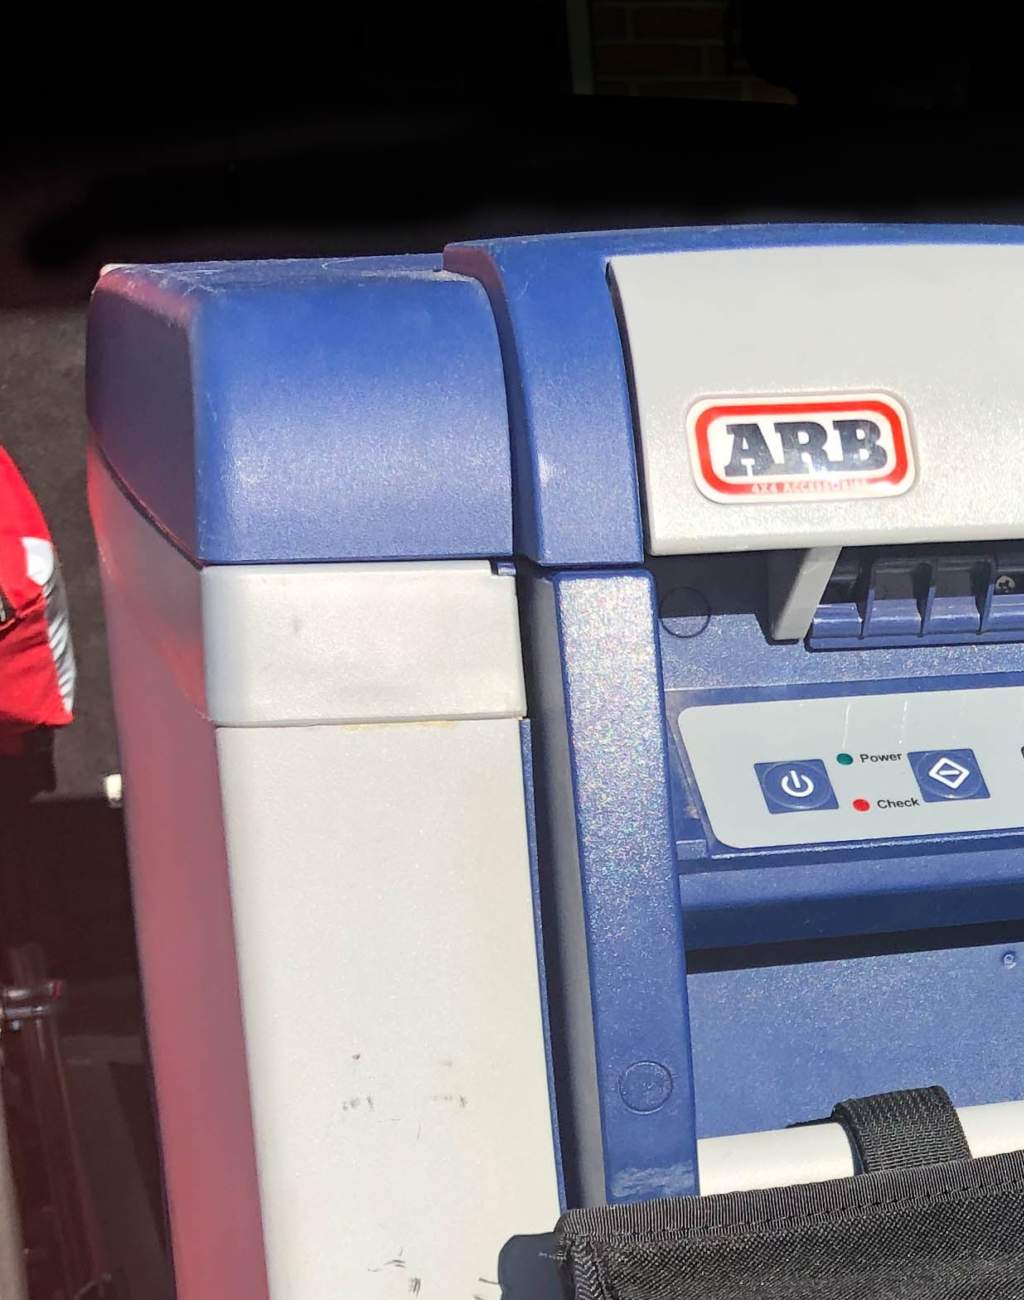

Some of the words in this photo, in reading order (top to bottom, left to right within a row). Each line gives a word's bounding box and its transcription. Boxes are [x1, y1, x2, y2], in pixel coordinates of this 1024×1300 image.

[724, 419, 888, 477] ARB
[860, 753, 902, 764] Power
[877, 797, 920, 809] Check
